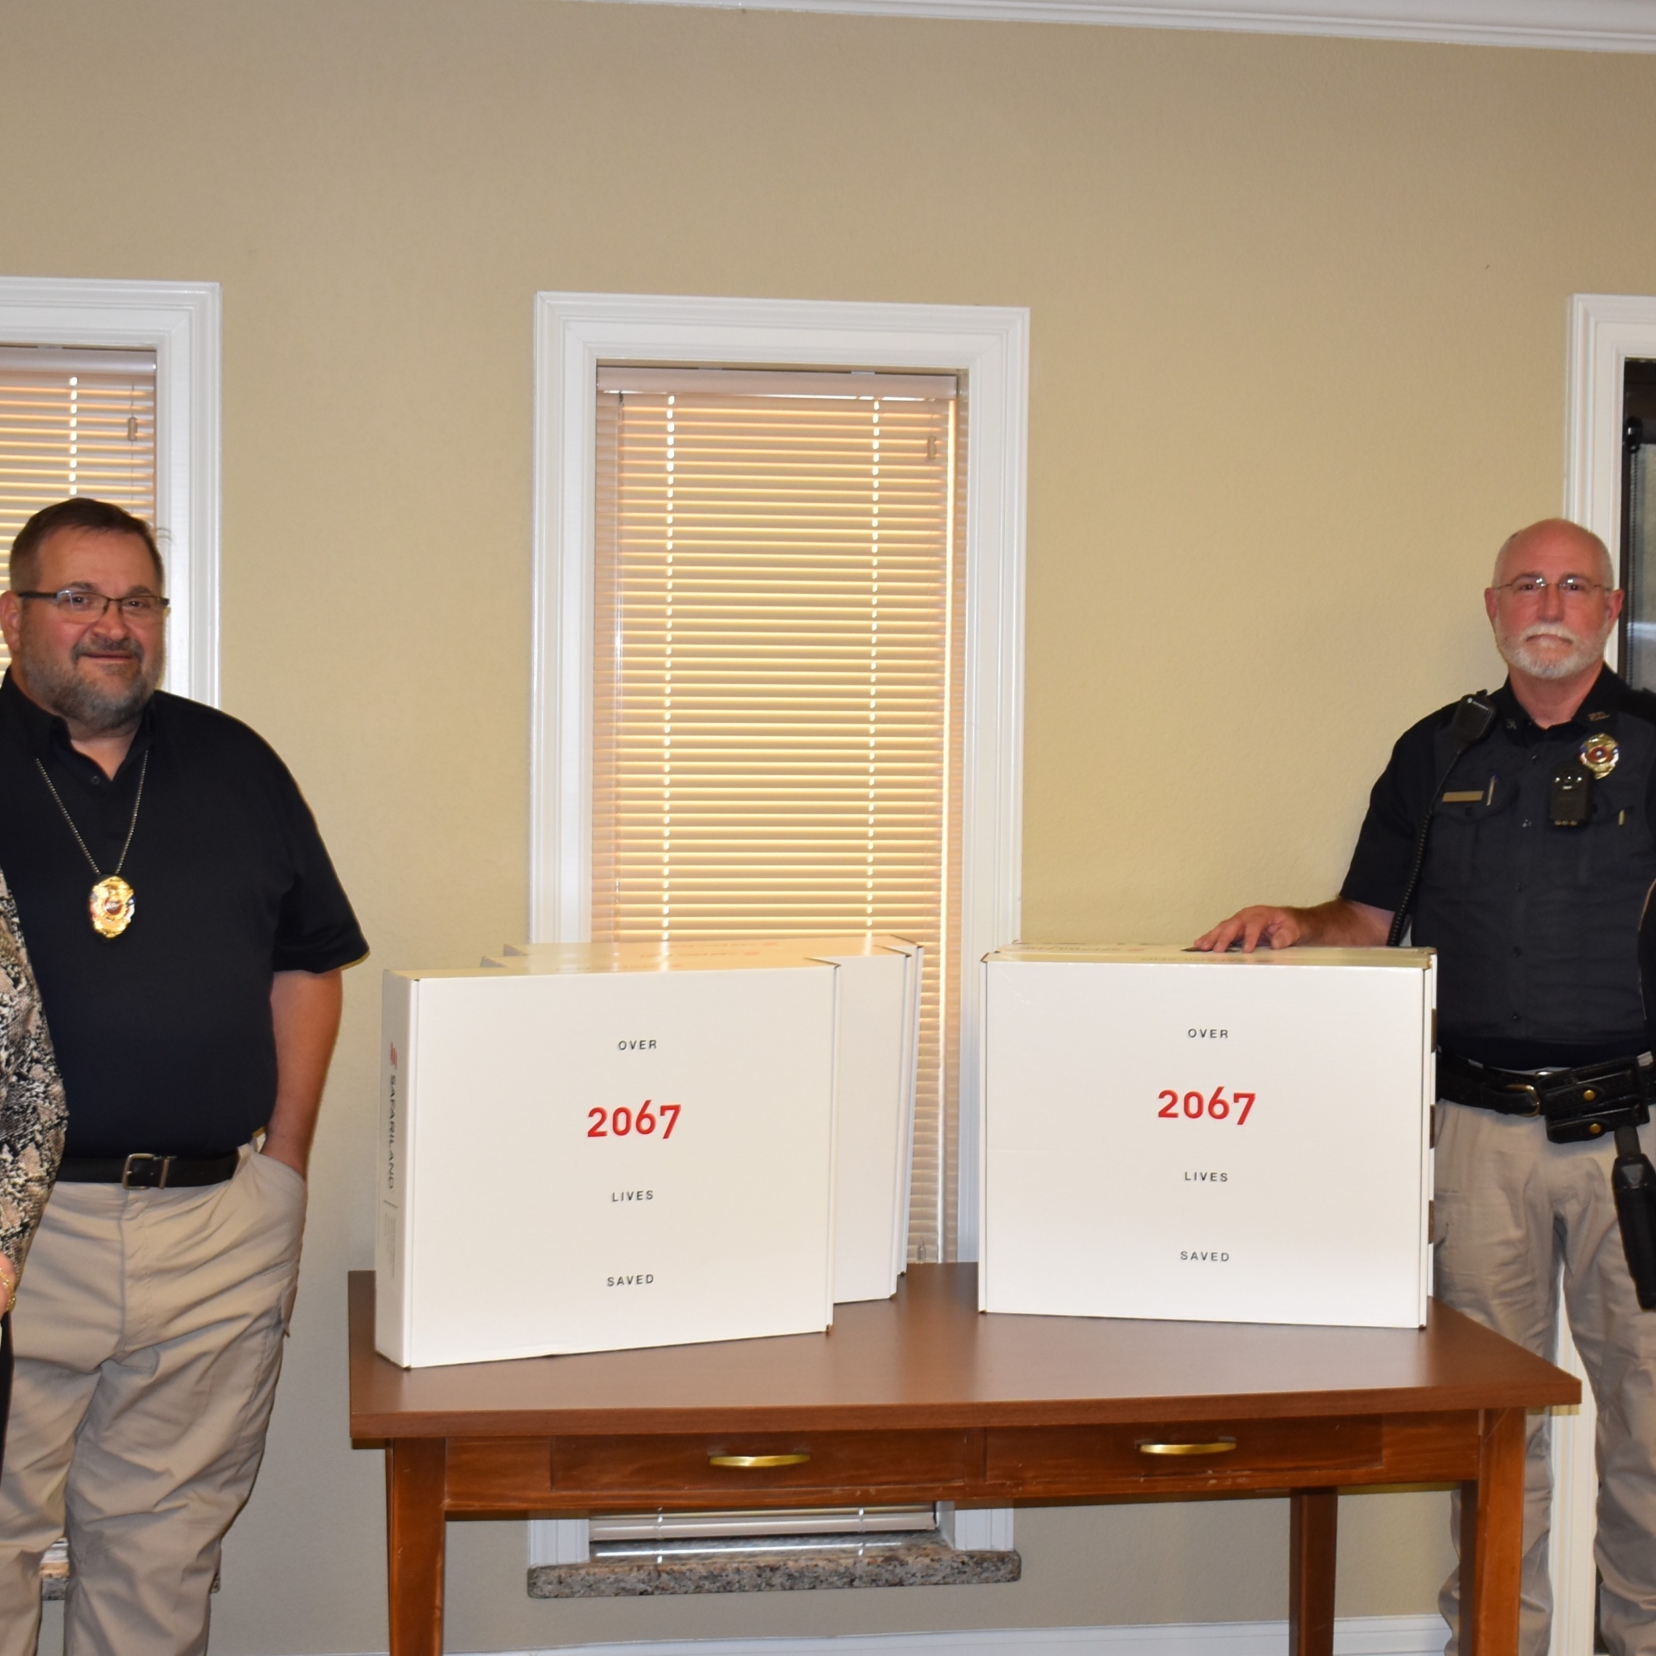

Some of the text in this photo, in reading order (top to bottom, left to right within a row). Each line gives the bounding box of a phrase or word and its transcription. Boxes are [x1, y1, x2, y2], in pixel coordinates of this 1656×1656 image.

[1187, 1028, 1229, 1039] OVER
[617, 1039, 657, 1051] OVER
[1158, 1086, 1256, 1126] 2067
[587, 1099, 681, 1140] 2067
[1184, 1171, 1229, 1183] LIVES
[611, 1189, 654, 1203] LIVES
[1179, 1250, 1230, 1263] SAVED
[606, 1273, 655, 1288] SAVED
